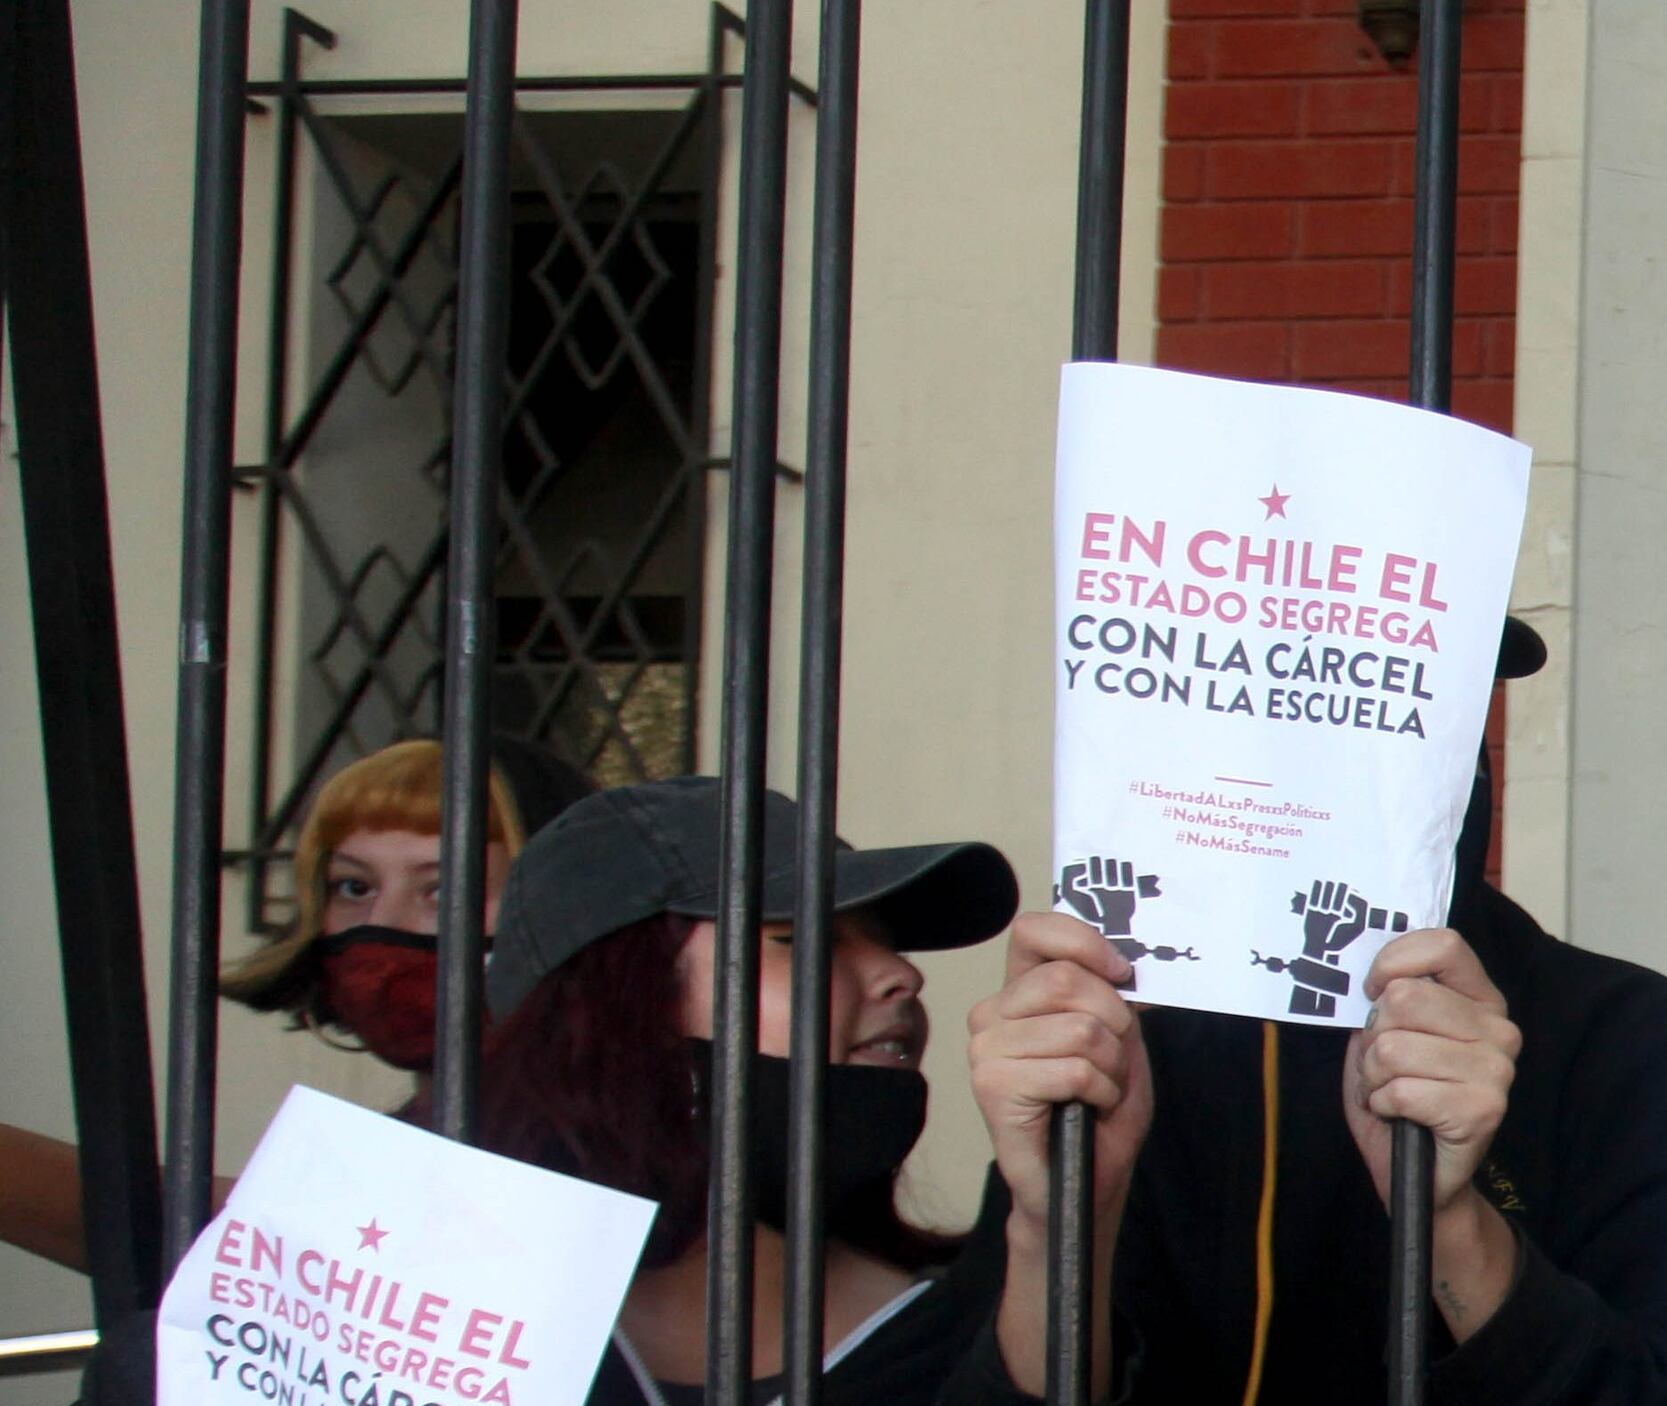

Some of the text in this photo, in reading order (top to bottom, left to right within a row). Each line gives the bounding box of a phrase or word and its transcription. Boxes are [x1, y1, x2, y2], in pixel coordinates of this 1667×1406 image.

[1081, 512, 1449, 612] EN CHILE EL
[1075, 569, 1440, 653] ESTADO SEGREGA
[1068, 614, 1434, 701] CON LA CÁRCEL
[1064, 658, 1426, 740] Y CON LA ESCUELA
[1175, 831, 1290, 859] #NoMásSename
[209, 1272, 330, 1342] ESTADO
[215, 1219, 531, 1371] EN CHILE EL
[205, 1350, 228, 1380] Y
[206, 1314, 292, 1370] CON
[298, 1346, 330, 1394] LA
